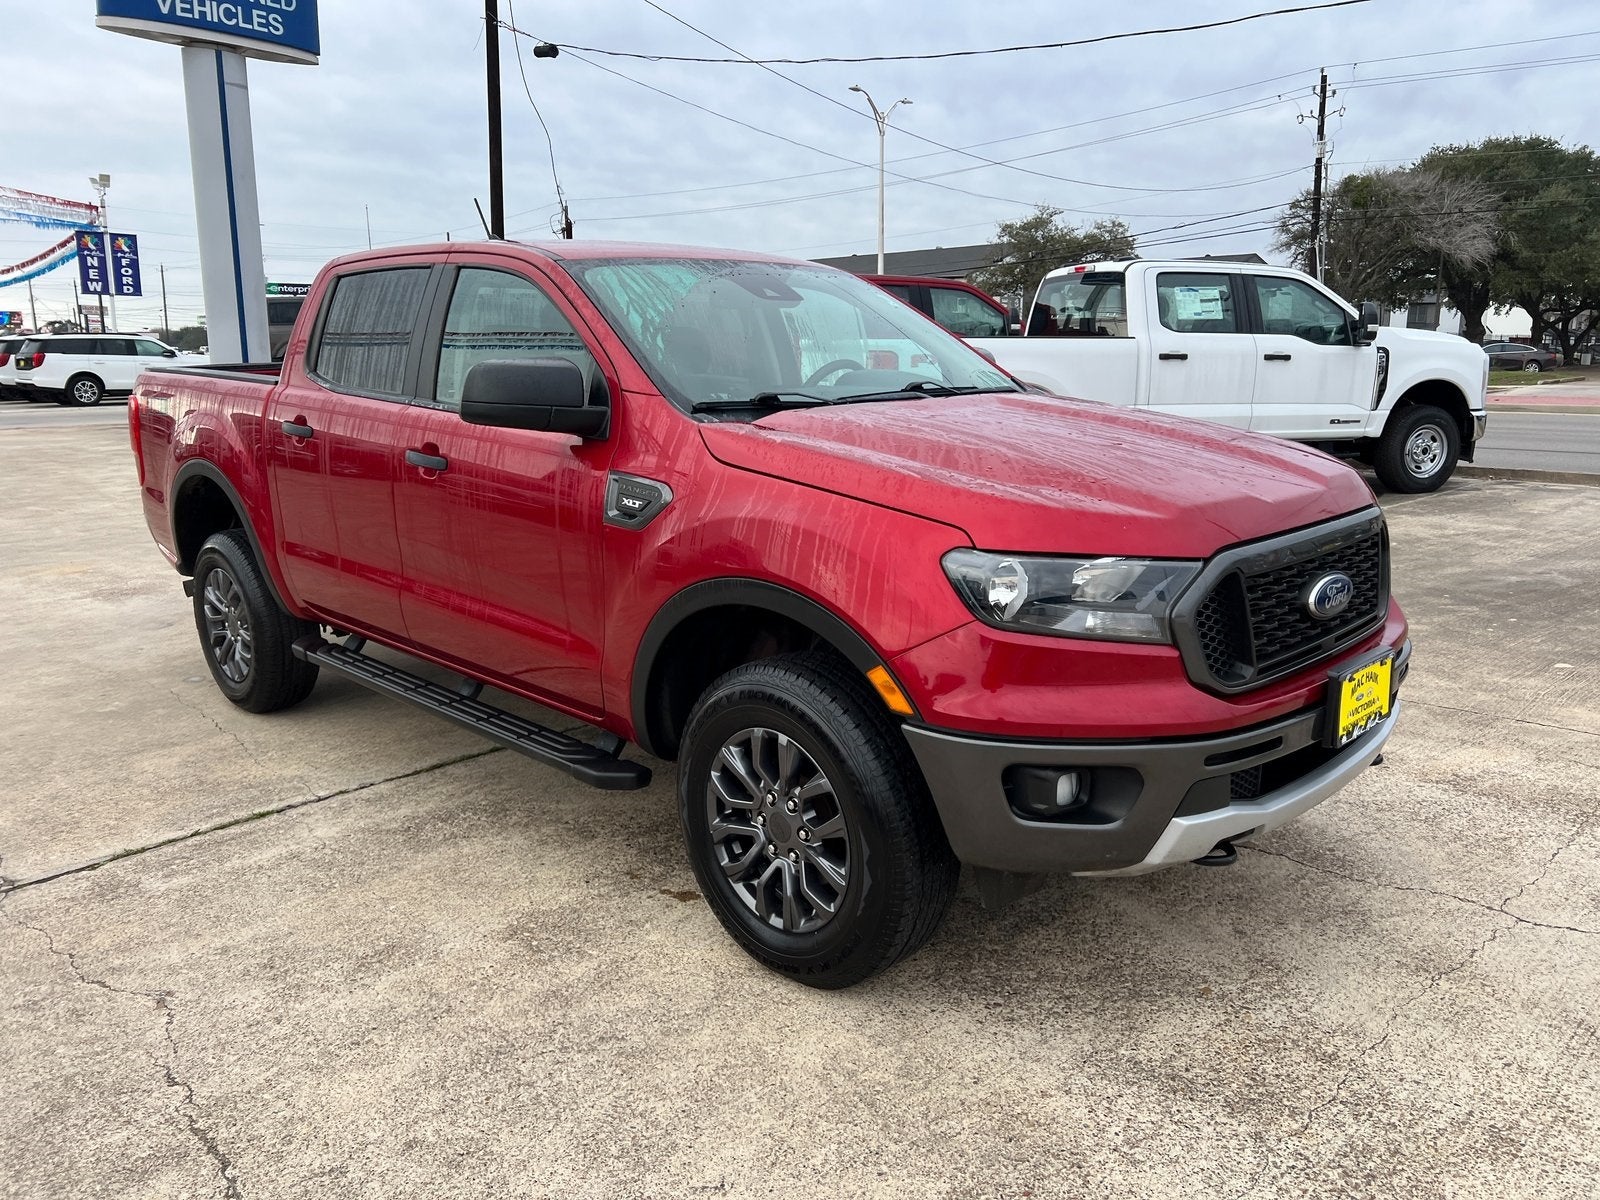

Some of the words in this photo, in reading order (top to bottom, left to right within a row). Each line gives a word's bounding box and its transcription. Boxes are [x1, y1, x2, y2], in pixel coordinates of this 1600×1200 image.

[157, 0, 284, 35] VEHICLES
[86, 256, 102, 292] NEW
[120, 258, 134, 294] FORD
[621, 497, 643, 509] XLT
[1325, 582, 1349, 609] Ford
[1351, 674, 1365, 699] MAC
[1365, 671, 1379, 685] HAIK
[1350, 698, 1377, 717] VICTORIA
